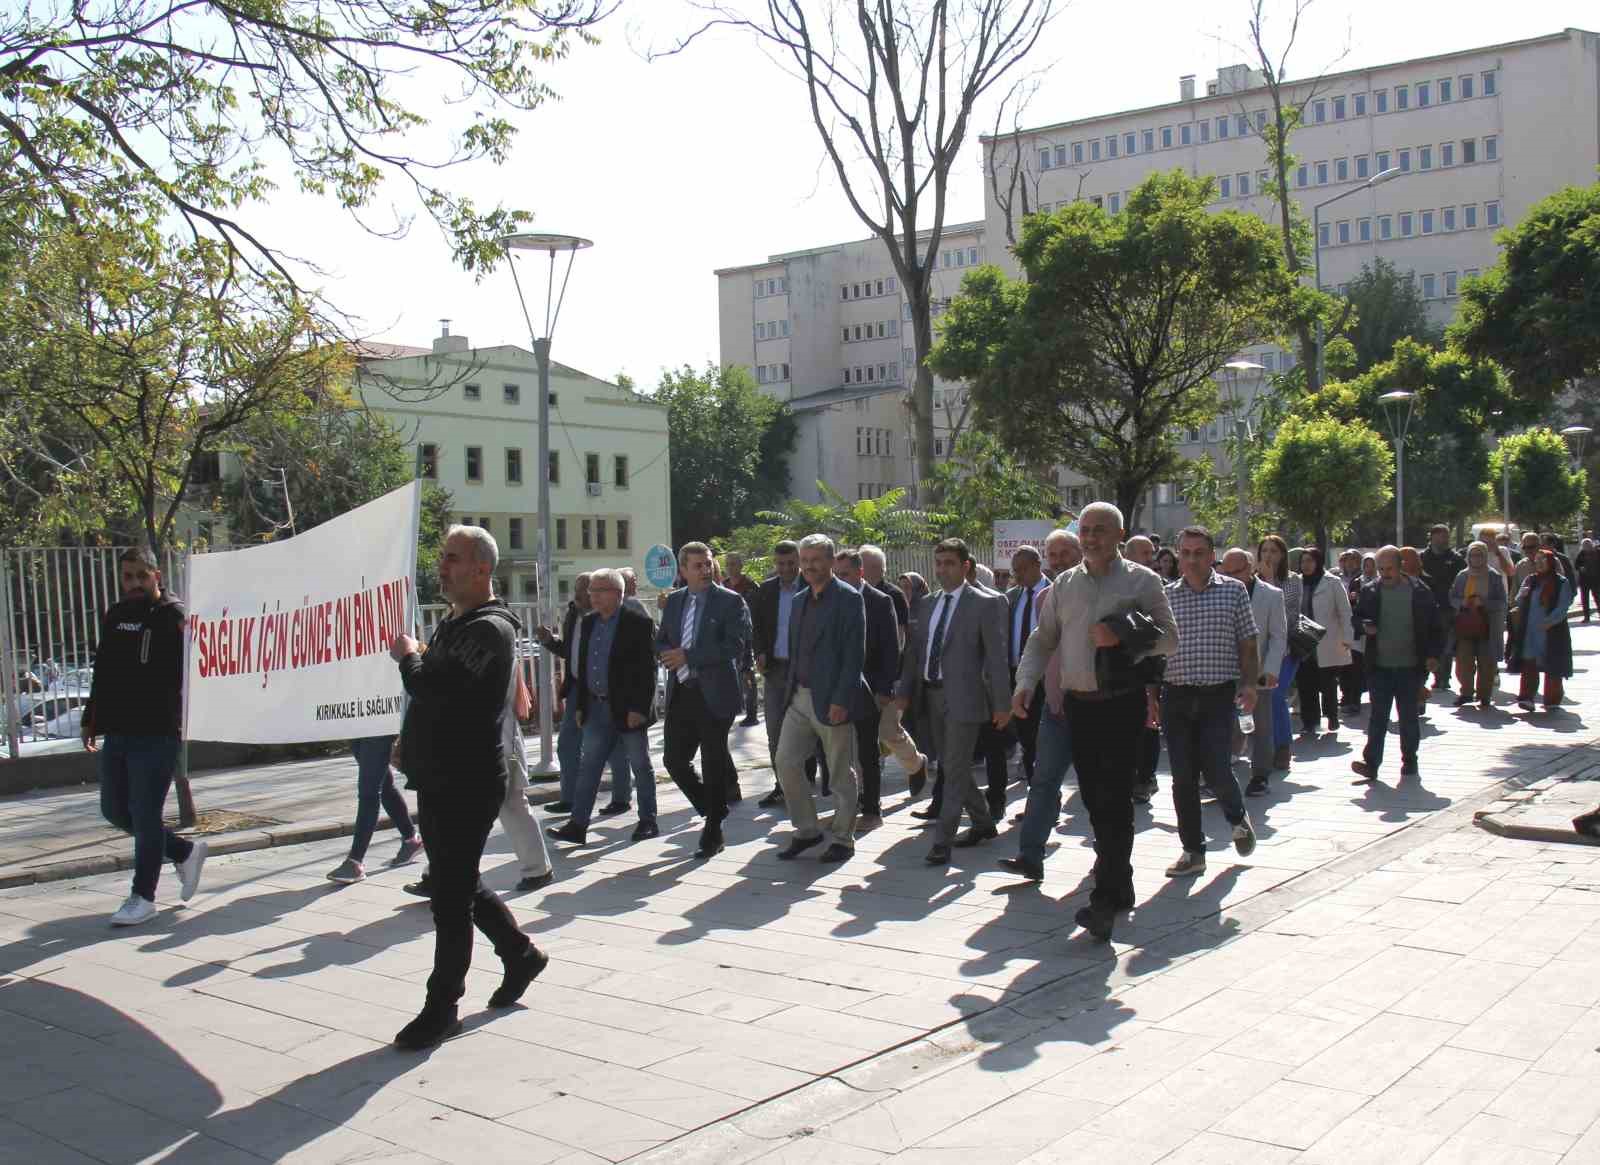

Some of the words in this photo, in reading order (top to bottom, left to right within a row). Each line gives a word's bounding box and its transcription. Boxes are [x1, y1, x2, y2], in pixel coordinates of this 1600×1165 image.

[257, 600, 288, 688] İÇİN
[291, 595, 332, 669] GÜNDE
[335, 598, 351, 661] ON
[354, 576, 375, 657] BİN
[316, 702, 355, 720] KIRIKKALE
[357, 696, 364, 717] İL
[366, 695, 393, 716] SAĞLIK
